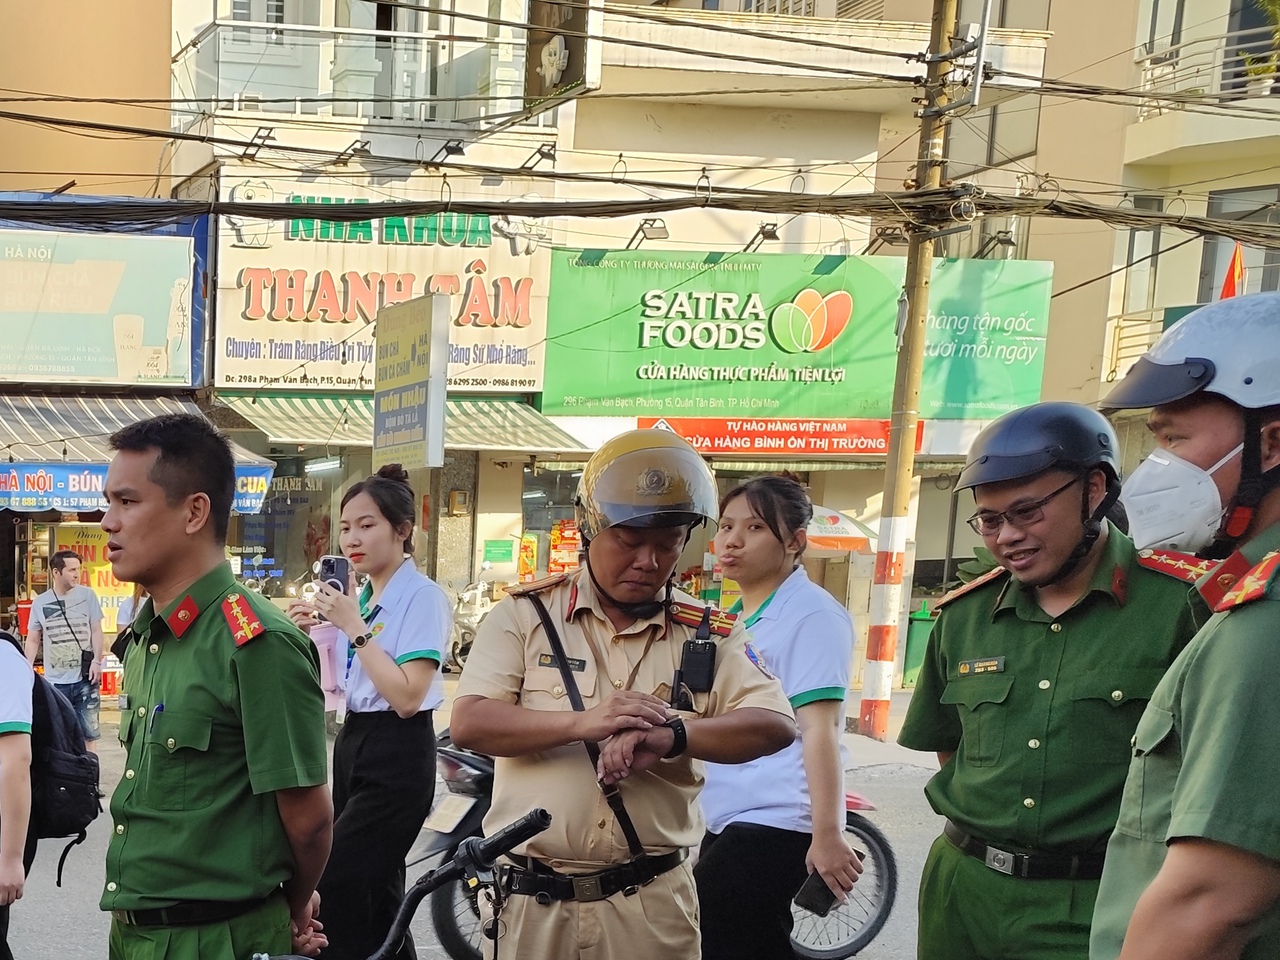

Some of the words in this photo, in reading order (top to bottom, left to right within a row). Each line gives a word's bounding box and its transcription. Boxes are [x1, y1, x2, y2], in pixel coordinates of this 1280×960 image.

[5, 244, 24, 259] HÀ
[27, 245, 52, 262] NỘI
[620, 260, 631, 269] TY
[641, 289, 767, 320] SATRA
[927, 309, 970, 335] hàng
[972, 311, 1002, 336] tận
[1002, 310, 1036, 336] gốc
[640, 320, 767, 350] FOODS
[225, 336, 262, 360] Chuyên
[268, 338, 293, 360] Trám
[447, 343, 471, 366] Răng
[923, 339, 958, 357] tươi
[958, 335, 995, 359] mỗi
[995, 341, 1038, 366] ngày
[238, 374, 258, 383] 298a
[259, 374, 280, 386] Phạm
[282, 376, 298, 384] Văn
[638, 360, 666, 380] CỬA
[669, 362, 709, 380] HÀNG
[712, 365, 748, 384] THỰC
[750, 361, 789, 382] PHẨM
[794, 367, 826, 386] TIỆN
[826, 367, 846, 386] LỢI
[453, 378, 470, 386] 6295
[470, 378, 488, 386] 2500
[492, 379, 510, 387] 0986
[563, 396, 577, 406] 296
[727, 420, 742, 433] TỰ
[743, 420, 766, 433] HÀO
[767, 421, 798, 433] HÀNG
[799, 421, 821, 434] VIỆT
[823, 422, 847, 433] NAM
[714, 434, 751, 448] HÀNG
[754, 434, 785, 449] BÌNH
[808, 436, 829, 451] THỊ
[832, 435, 886, 449] TRƯỜNG
[24, 469, 53, 495] NỘI
[68, 470, 104, 493] BÚN
[237, 476, 268, 494] CUA
[79, 497, 98, 508] PHẠM
